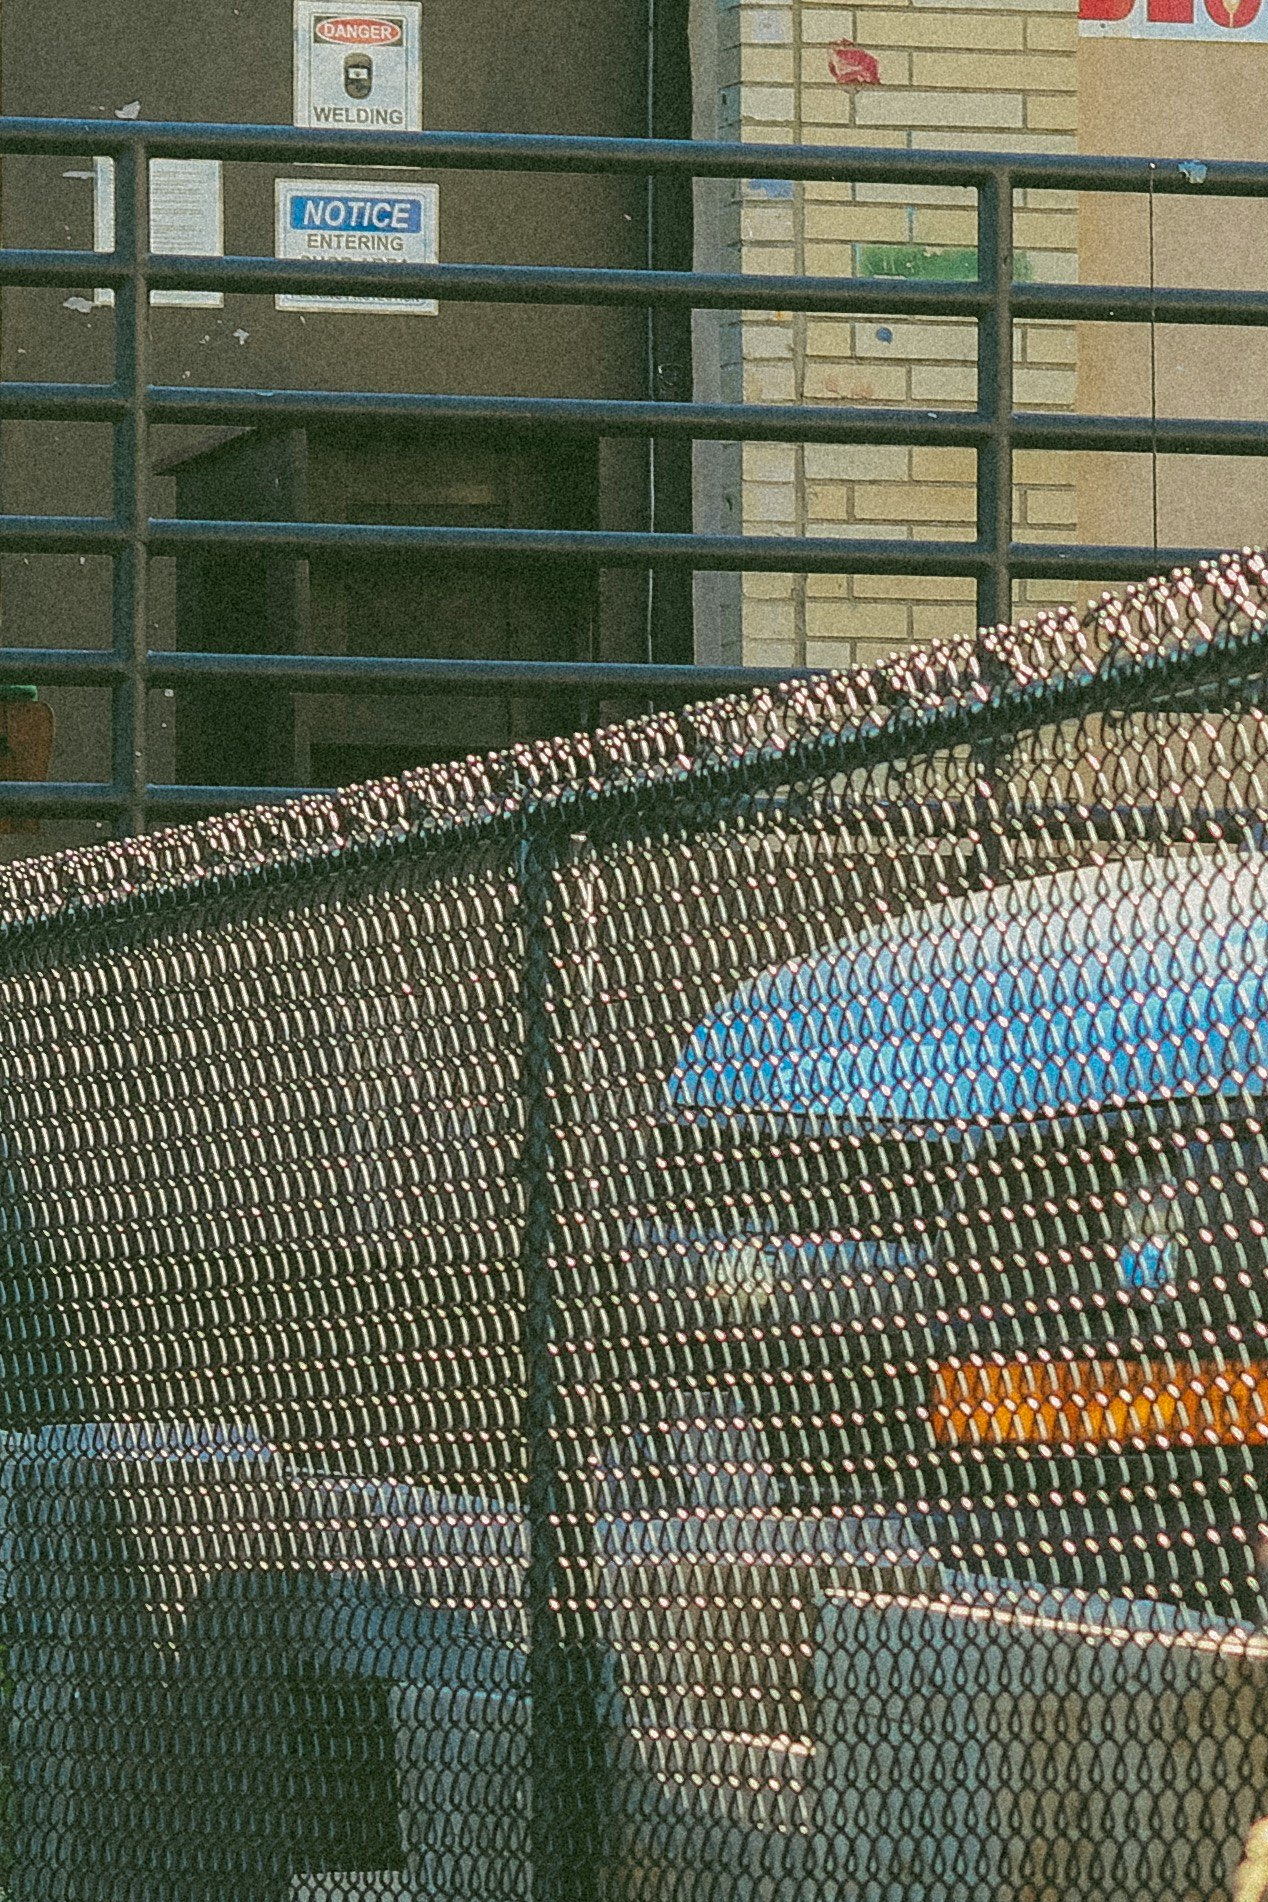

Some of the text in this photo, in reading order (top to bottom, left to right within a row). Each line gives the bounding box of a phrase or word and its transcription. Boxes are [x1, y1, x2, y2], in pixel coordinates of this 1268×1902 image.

[323, 23, 392, 40] DANGER
[313, 106, 403, 125] WELDING
[303, 200, 411, 228] NOTICE
[307, 233, 404, 252] ENTERING
